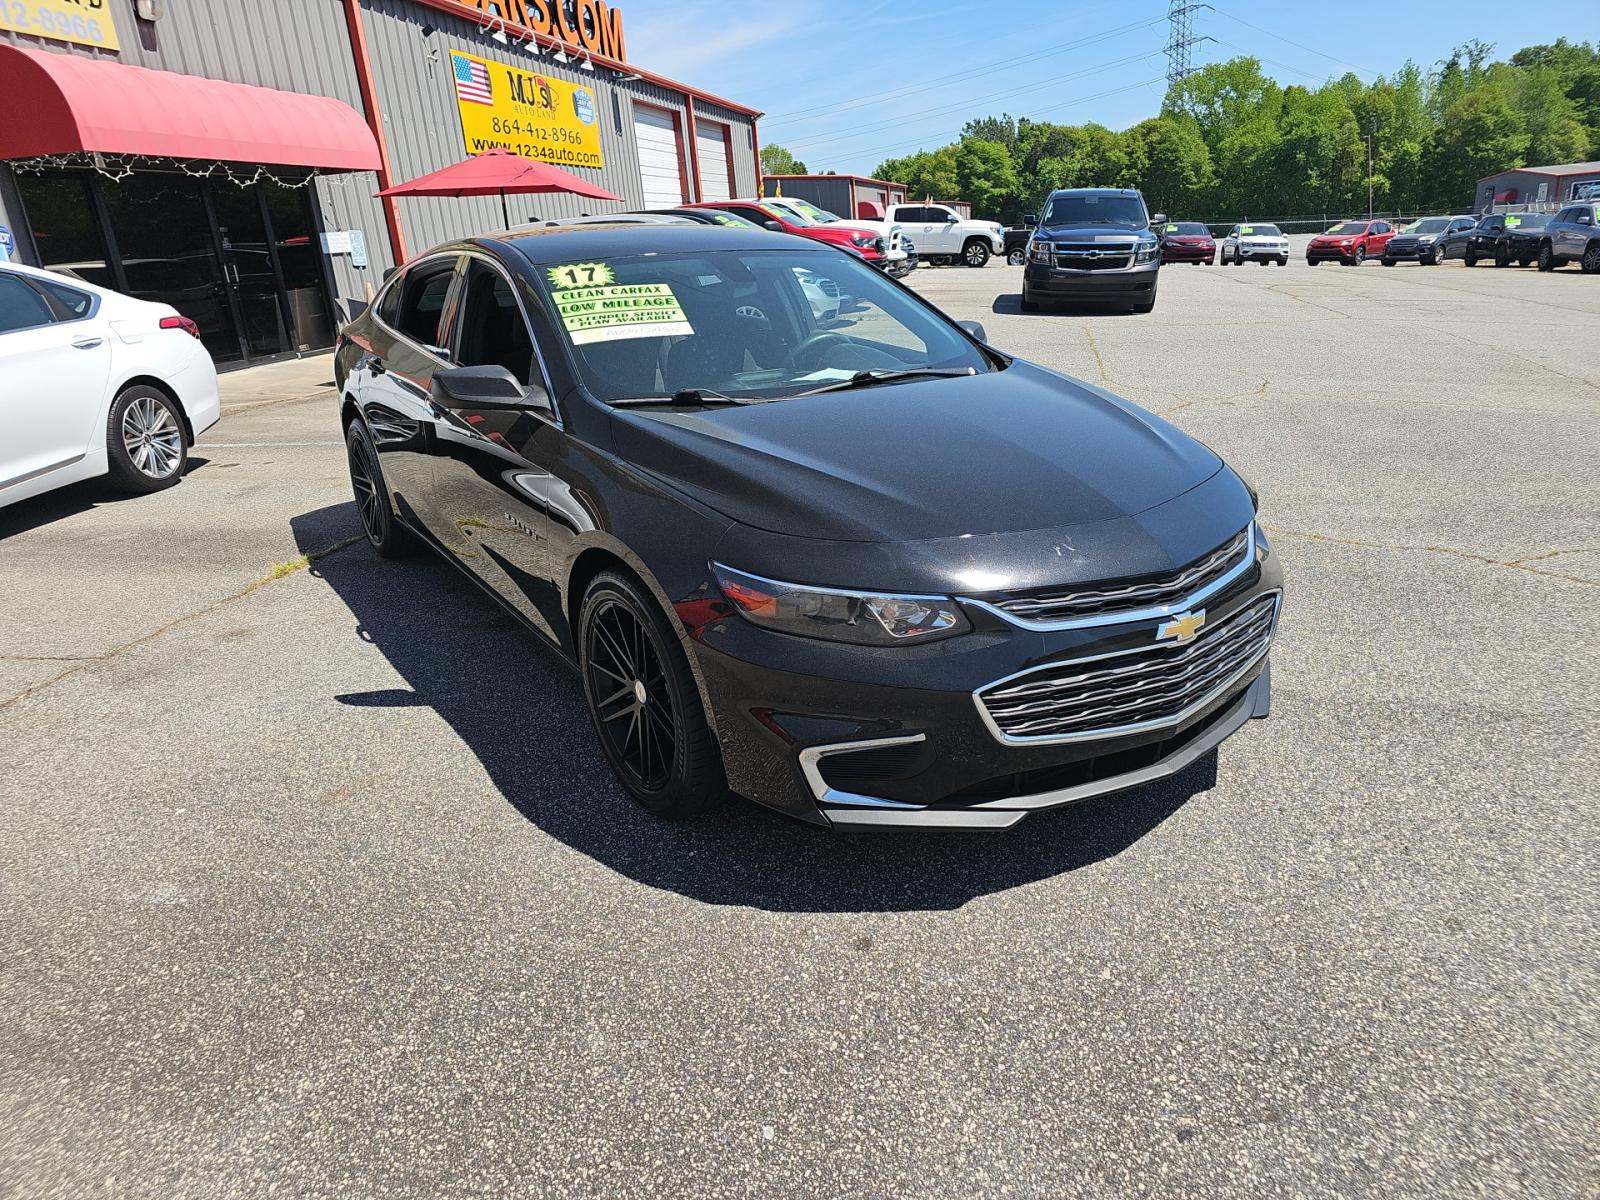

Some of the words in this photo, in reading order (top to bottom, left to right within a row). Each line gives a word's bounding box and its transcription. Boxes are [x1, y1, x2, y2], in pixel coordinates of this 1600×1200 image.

[467, 0, 627, 64] S.COM
[492, 117, 582, 145] 864-412-8966
[472, 138, 600, 165] www1234auto.com
[565, 267, 596, 284] 17
[561, 289, 605, 301] CLEAN
[611, 285, 662, 296] CARFAX
[561, 302, 597, 315] LOW
[602, 297, 675, 310] MILEAGE
[569, 312, 630, 324] EXTENDED
[633, 310, 678, 318] SERVICE
[580, 318, 610, 327] PLAN
[618, 315, 673, 324] AVAILABLE
